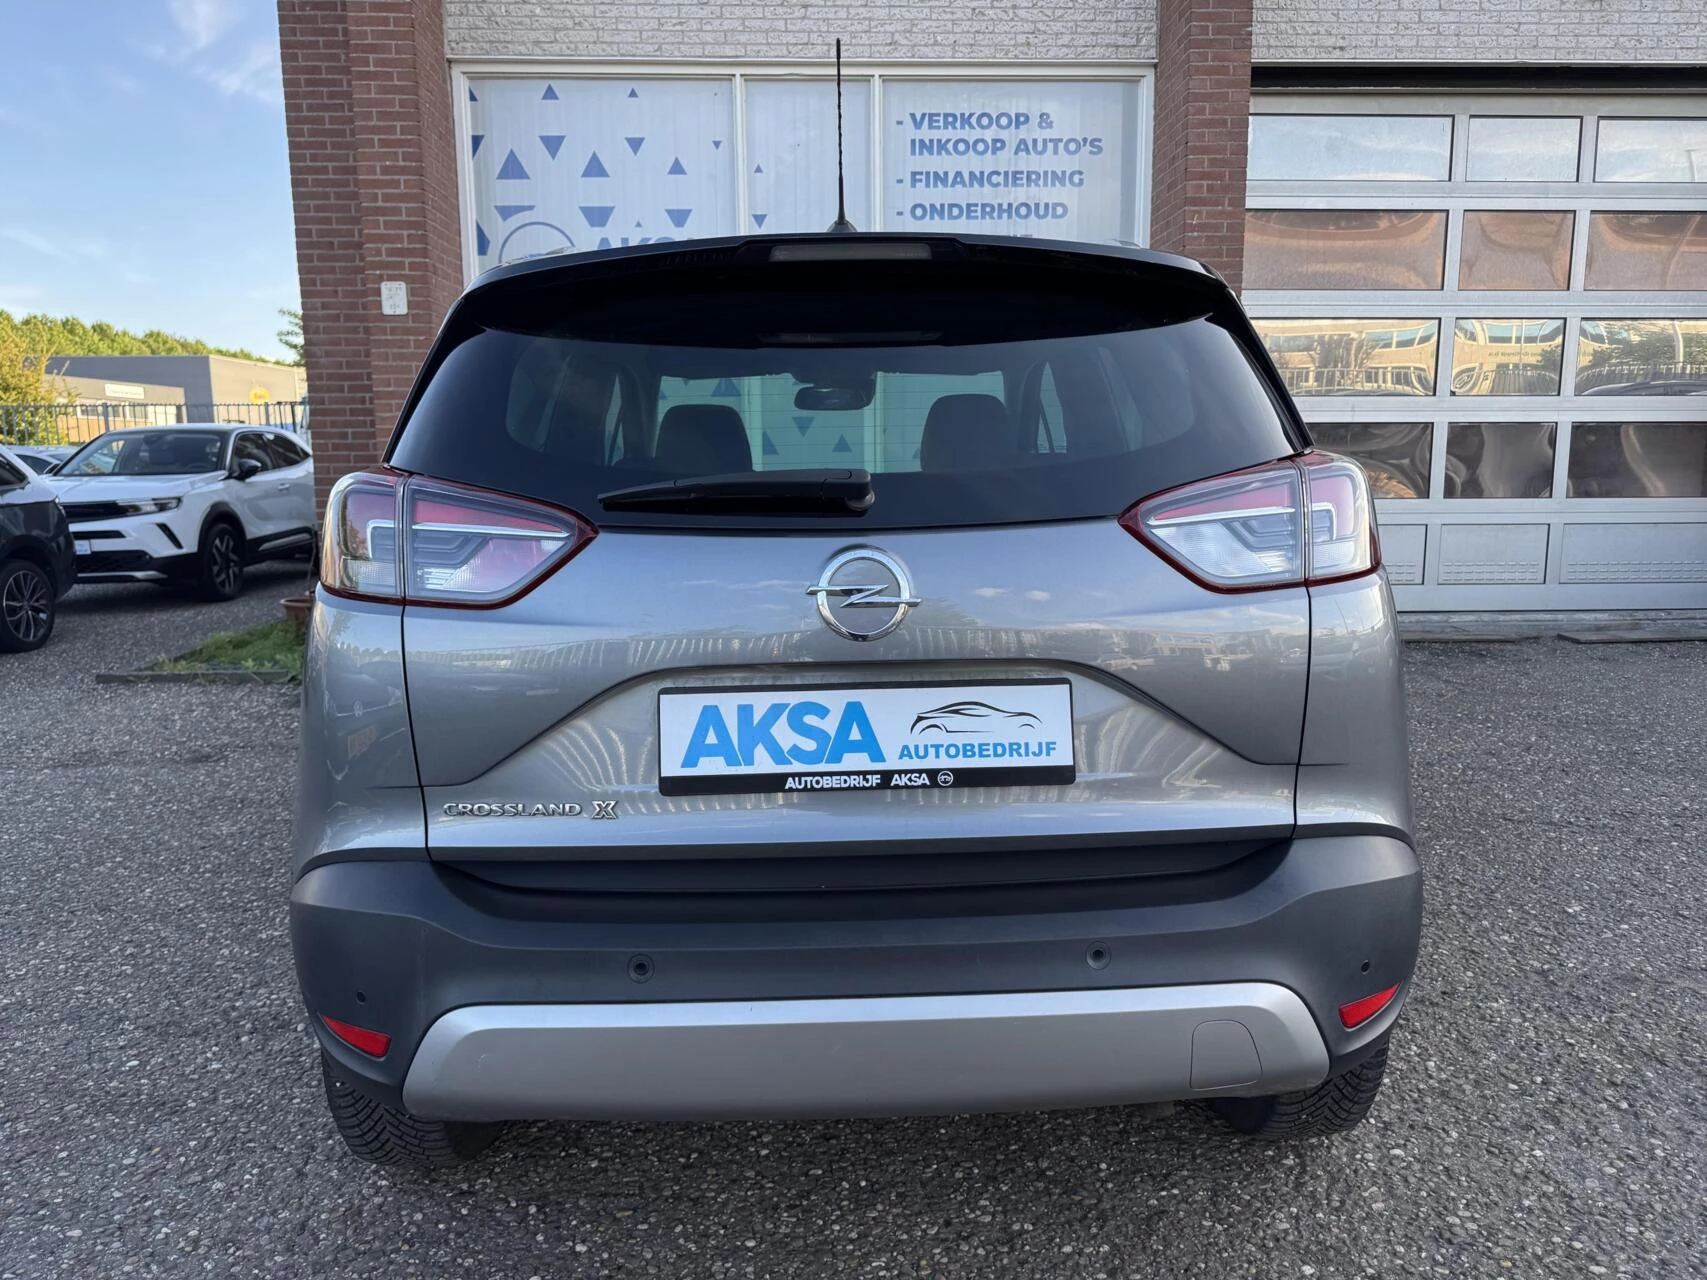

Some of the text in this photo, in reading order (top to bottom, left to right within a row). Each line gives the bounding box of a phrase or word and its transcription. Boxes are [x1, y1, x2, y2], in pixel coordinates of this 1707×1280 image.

[909, 112, 1030, 130] VERKOOP
[1037, 112, 1054, 130] &
[910, 137, 1104, 156] INKOOP AUTO'S
[910, 170, 1085, 188] FINANCIERING
[910, 202, 1069, 221] ONDERHOUD
[680, 701, 887, 769] AKSA
[897, 741, 1057, 760] AUTOBEDRIJF
[784, 773, 930, 790] AUTOBEDRIJF AKSA
[443, 800, 619, 820] CROSSLAND X
